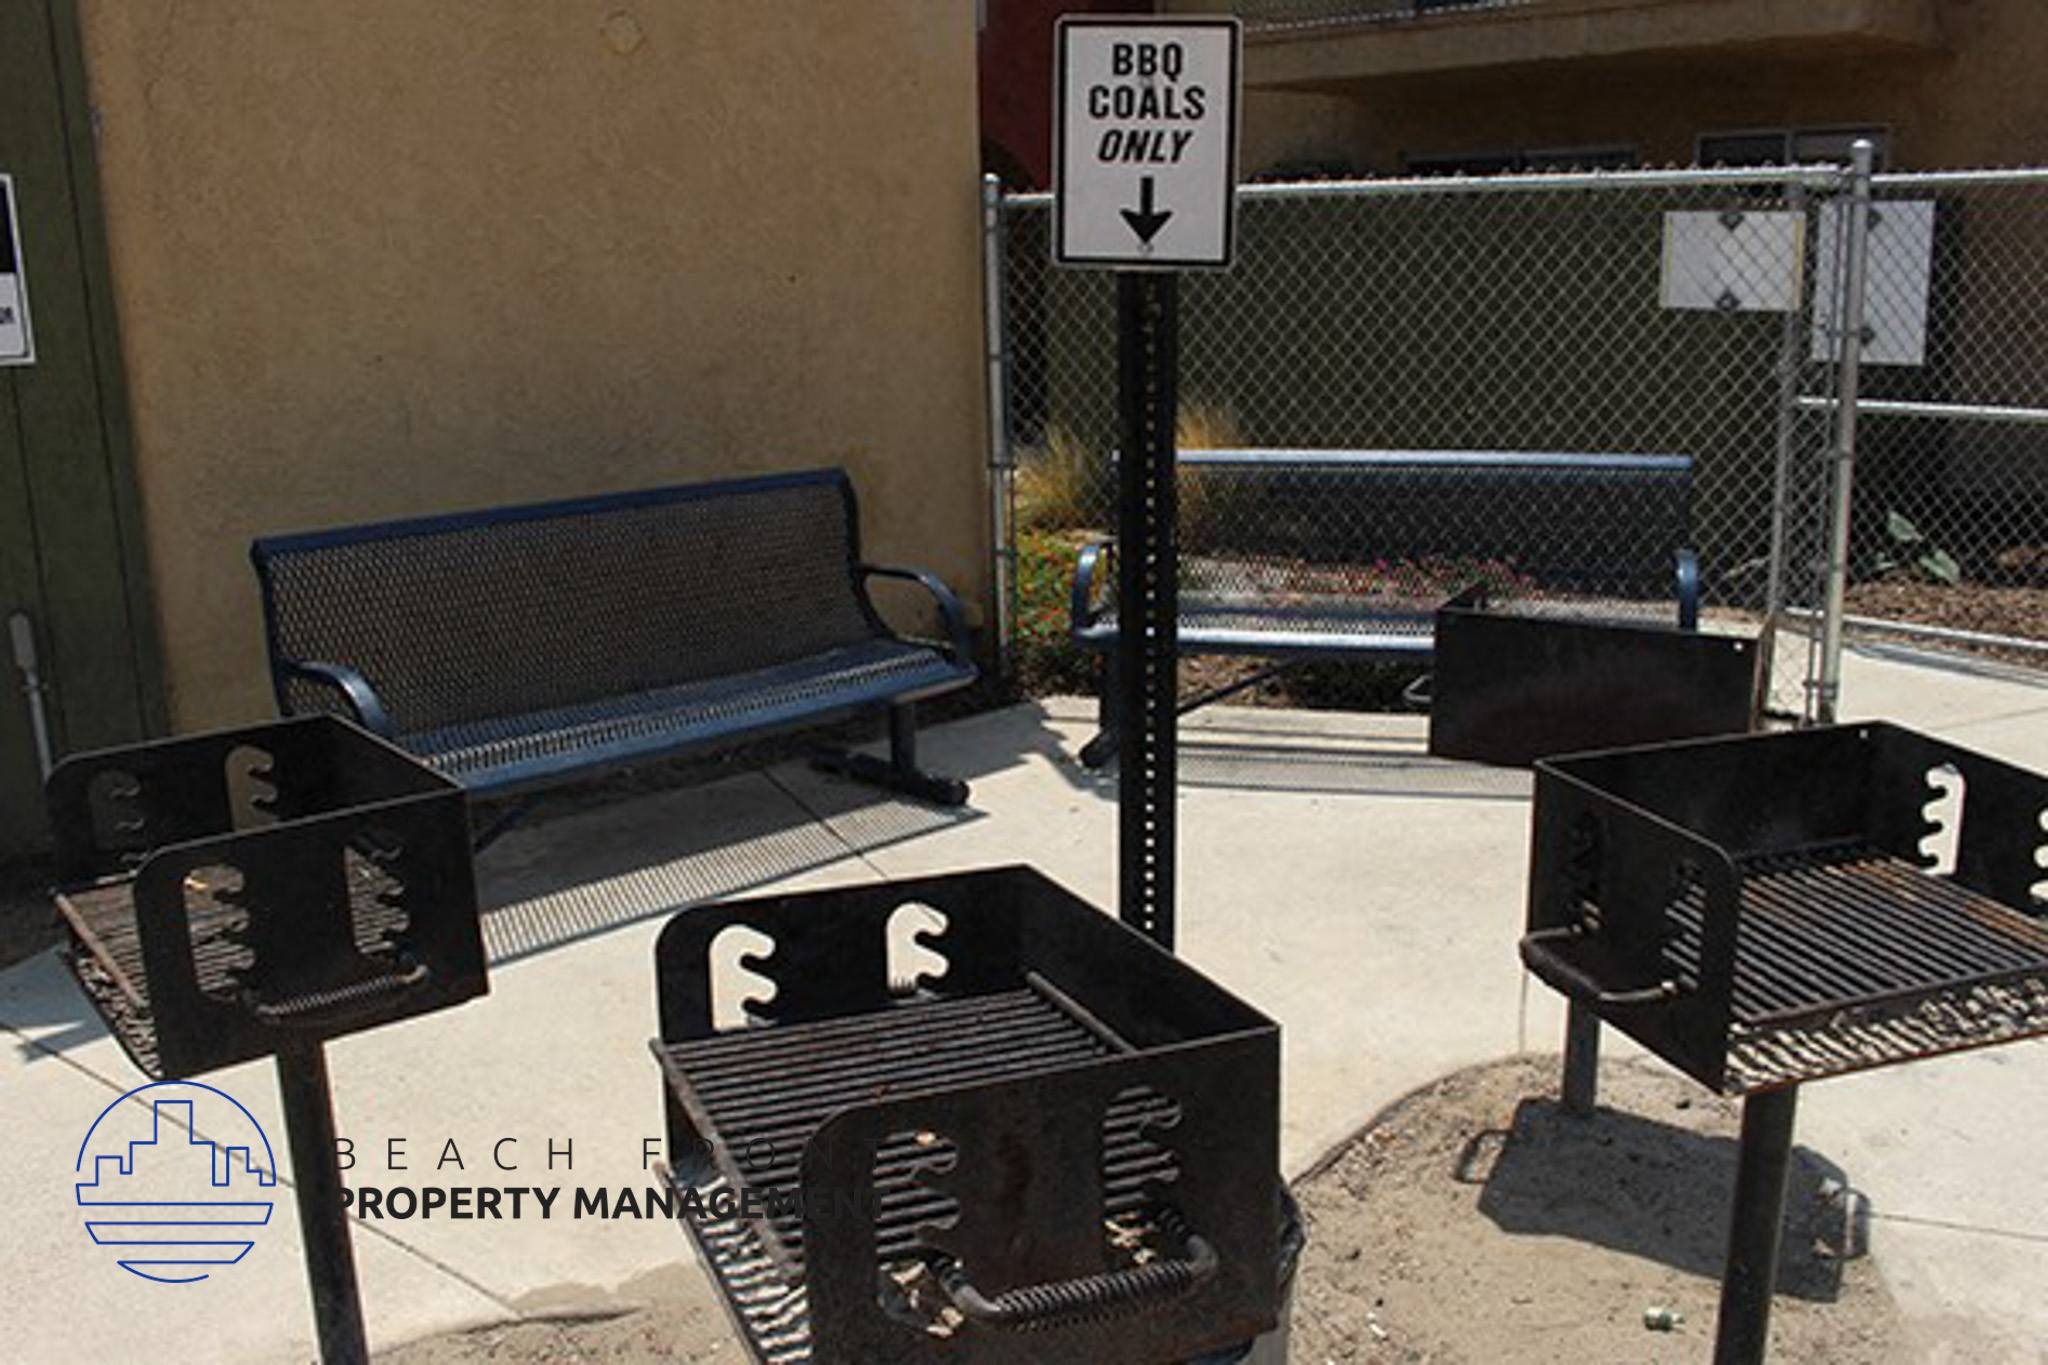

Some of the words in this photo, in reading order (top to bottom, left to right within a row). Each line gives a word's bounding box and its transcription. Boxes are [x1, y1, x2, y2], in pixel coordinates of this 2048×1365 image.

[1112, 42, 1183, 82] BBQ
[1088, 85, 1206, 120] COALS
[1098, 129, 1194, 163] ONLY
